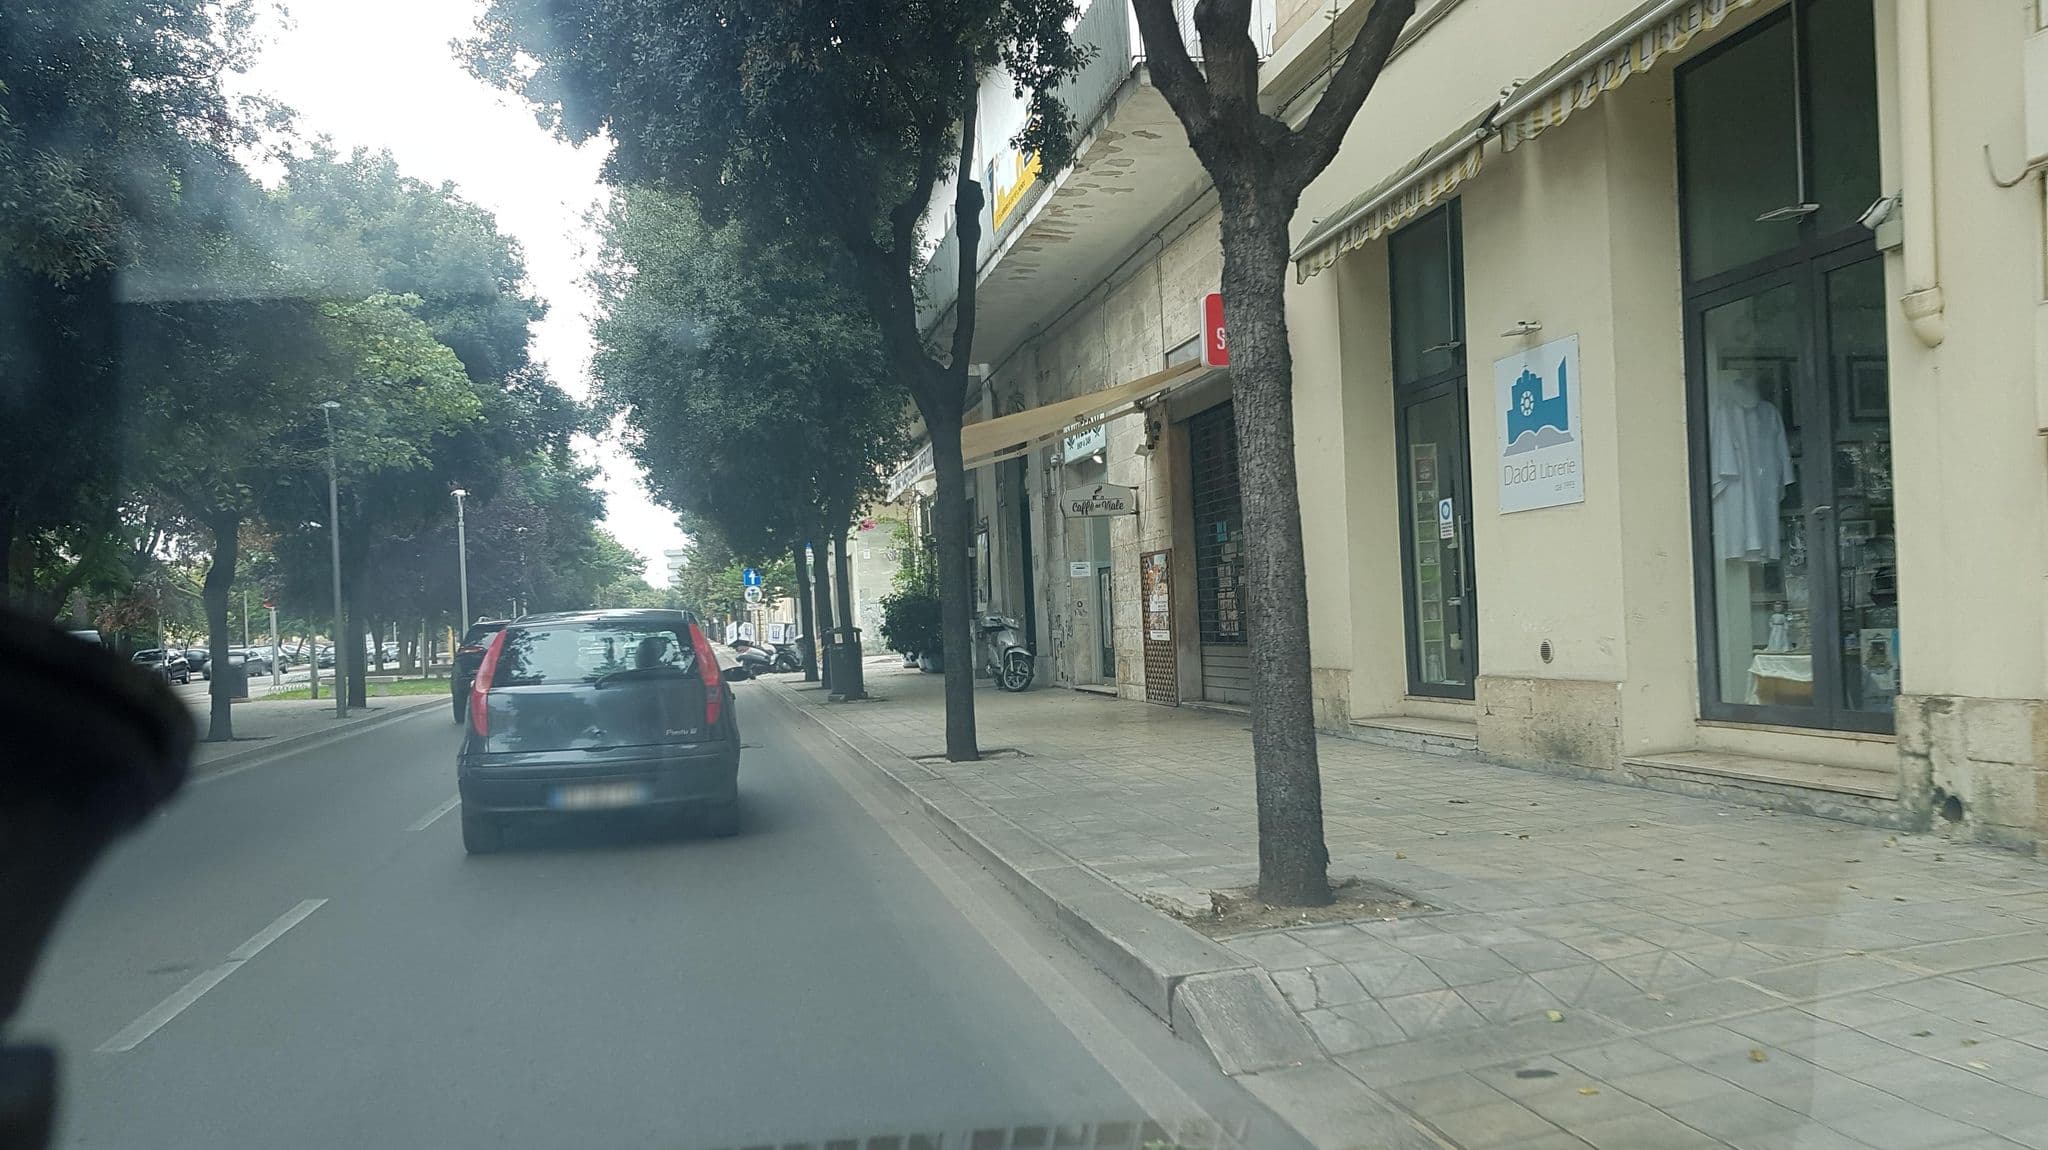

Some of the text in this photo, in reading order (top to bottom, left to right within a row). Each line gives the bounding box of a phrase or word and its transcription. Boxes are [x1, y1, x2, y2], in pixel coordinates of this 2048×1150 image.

[1640, 0, 1741, 62] LIBRERI
[1216, 327, 1226, 350] S
[1504, 458, 1576, 486] Dadà Librerie
[1102, 499, 1124, 511] Viale
